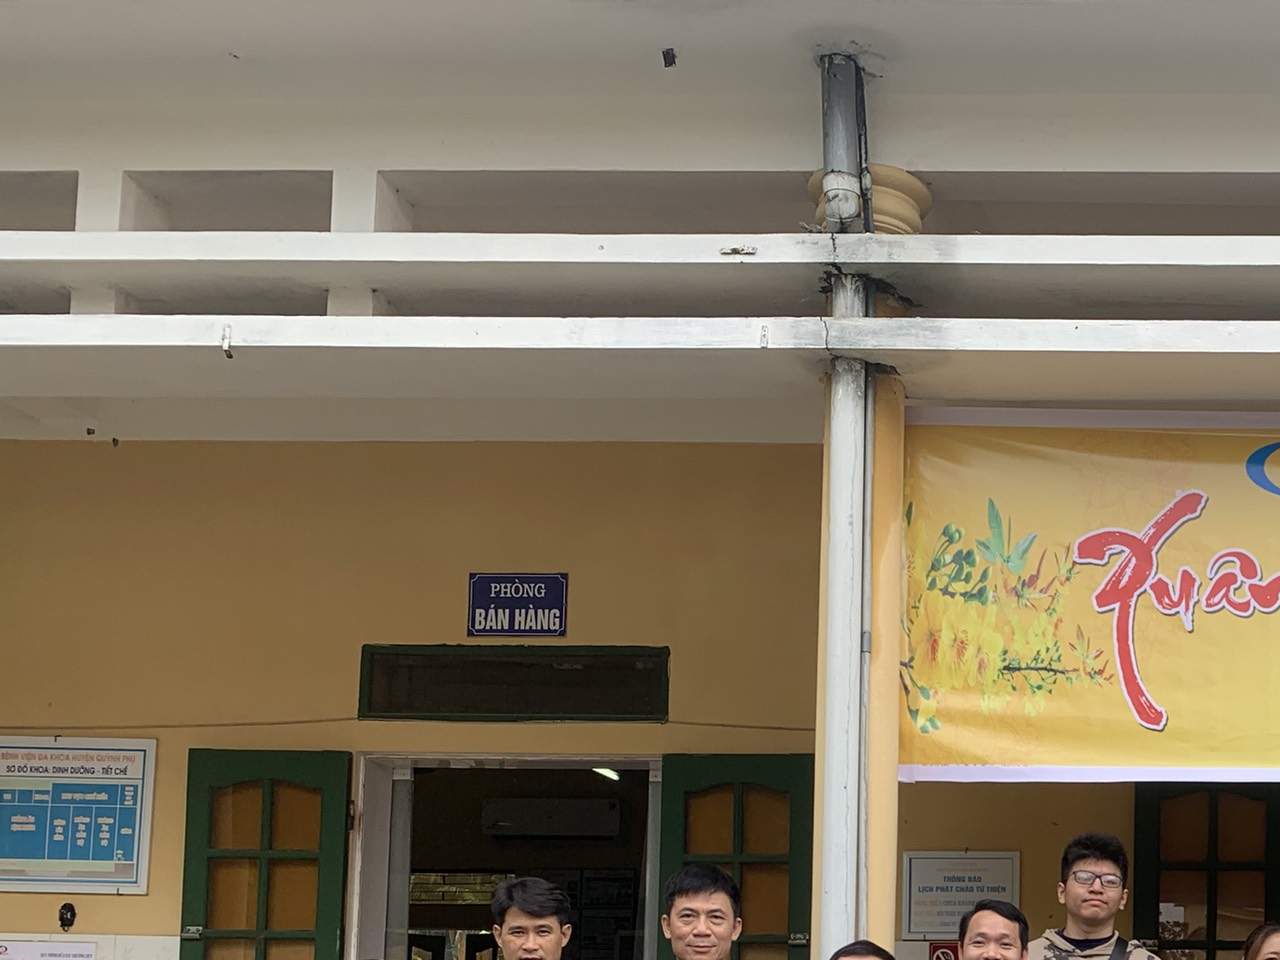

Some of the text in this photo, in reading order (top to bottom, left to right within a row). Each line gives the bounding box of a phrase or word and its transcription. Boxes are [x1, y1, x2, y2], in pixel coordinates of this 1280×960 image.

[490, 578, 547, 598] PHÒNG
[474, 604, 561, 631] BÁN HÀNG
[52, 766, 69, 775] DINH
